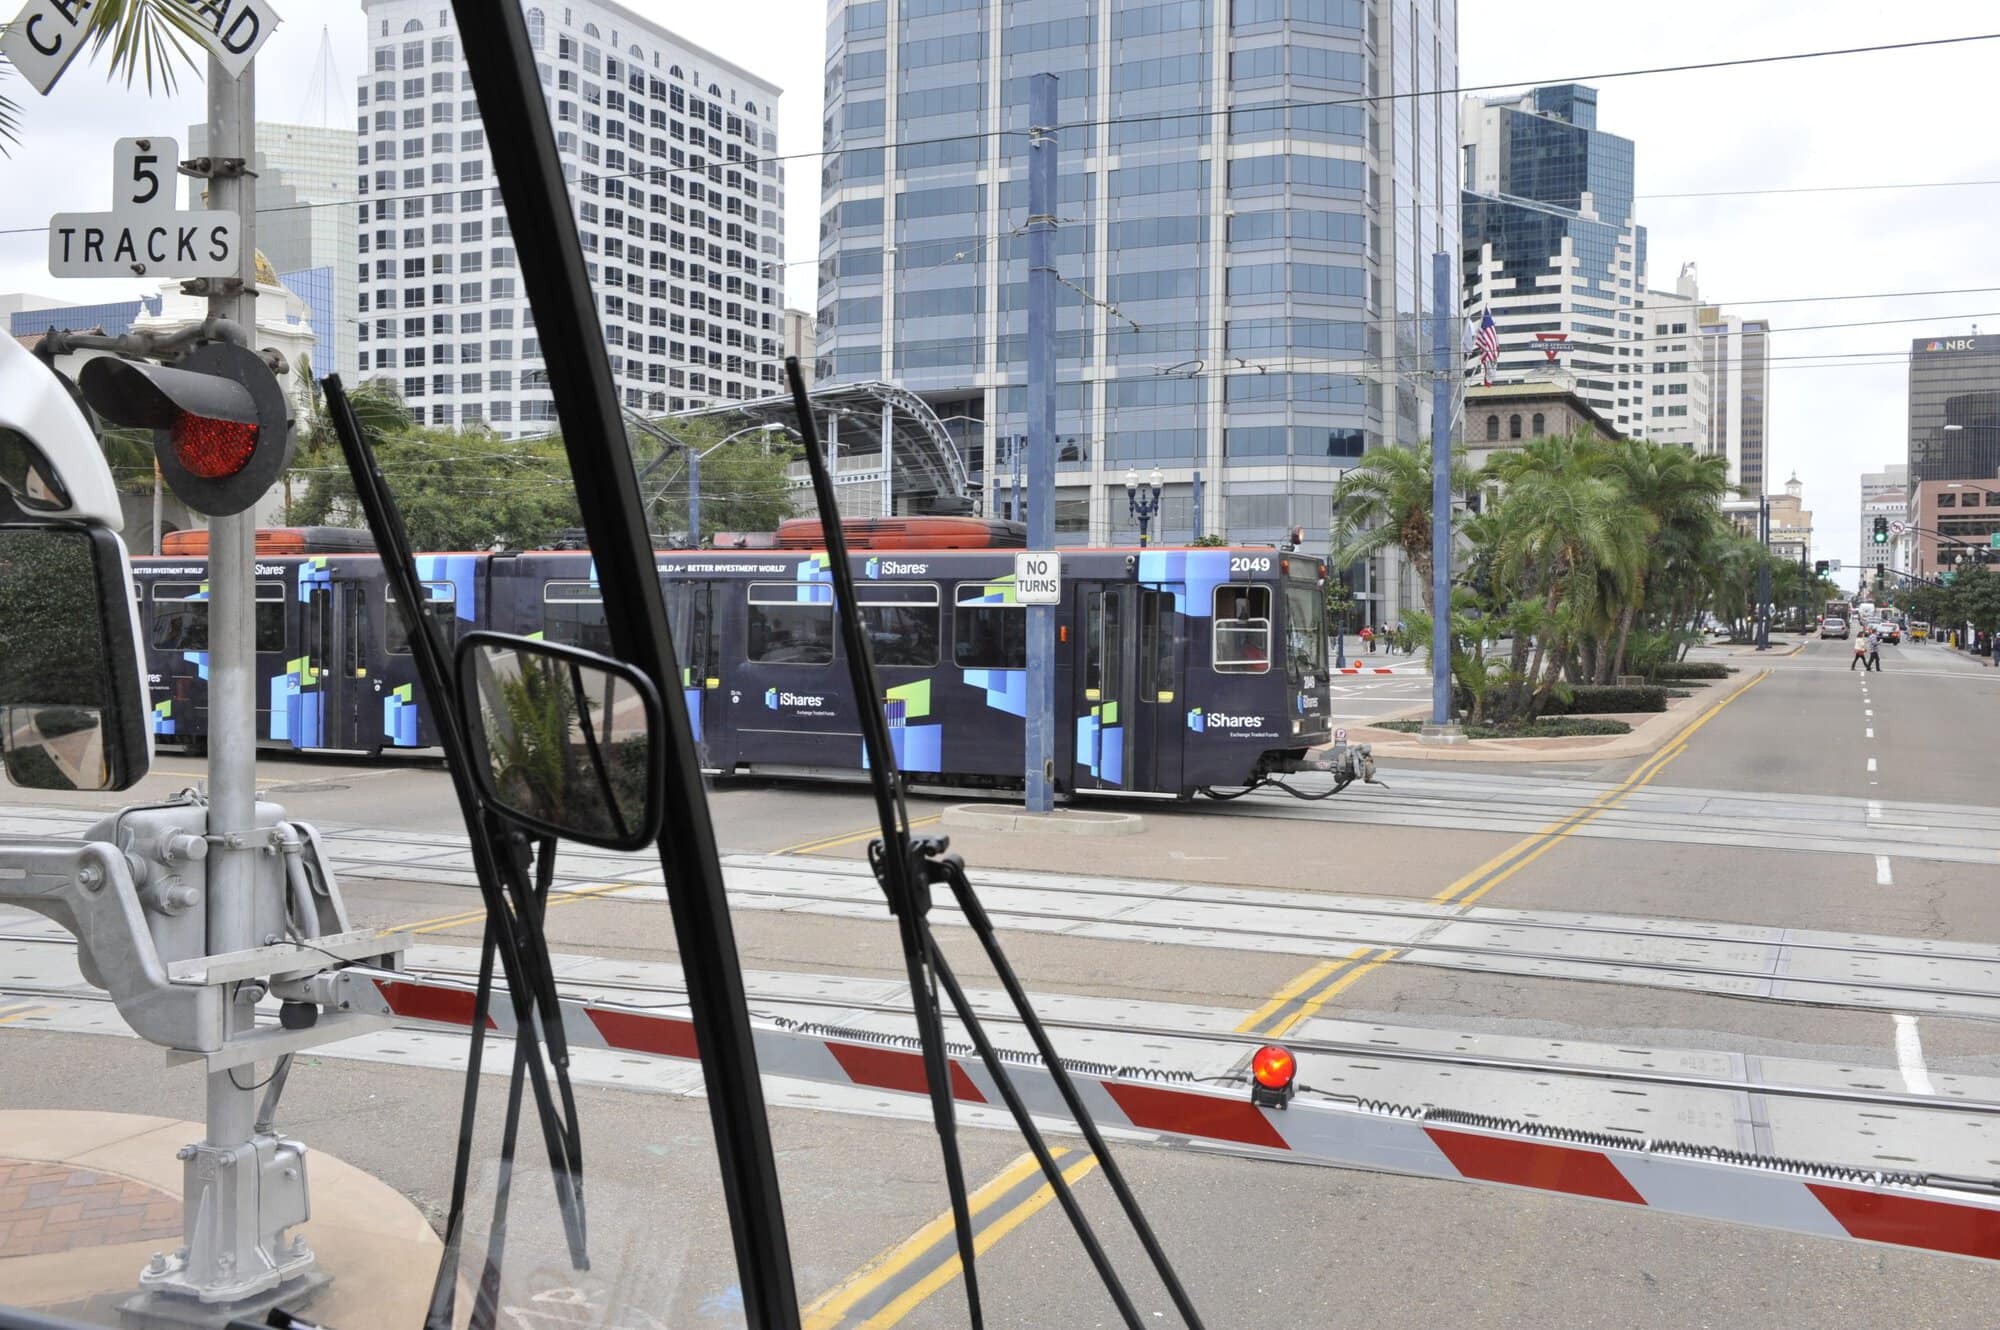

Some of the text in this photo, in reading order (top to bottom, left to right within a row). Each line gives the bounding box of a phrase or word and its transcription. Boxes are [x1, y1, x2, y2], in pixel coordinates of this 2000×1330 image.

[132, 155, 159, 204] 5
[58, 226, 229, 263] TRACKS
[1945, 339, 1976, 351] NBC
[254, 564, 284, 576] Shares
[657, 564, 674, 573] UILD
[687, 564, 714, 573] BETTER
[714, 564, 758, 573] INVESTMENT
[758, 564, 784, 573] WORLD
[881, 561, 927, 575] iShares
[1026, 560, 1048, 575] NO
[1230, 557, 1271, 572] 2049
[1018, 579, 1057, 593] TURNS
[780, 692, 823, 707] iShares
[1206, 712, 1262, 728] iShares
